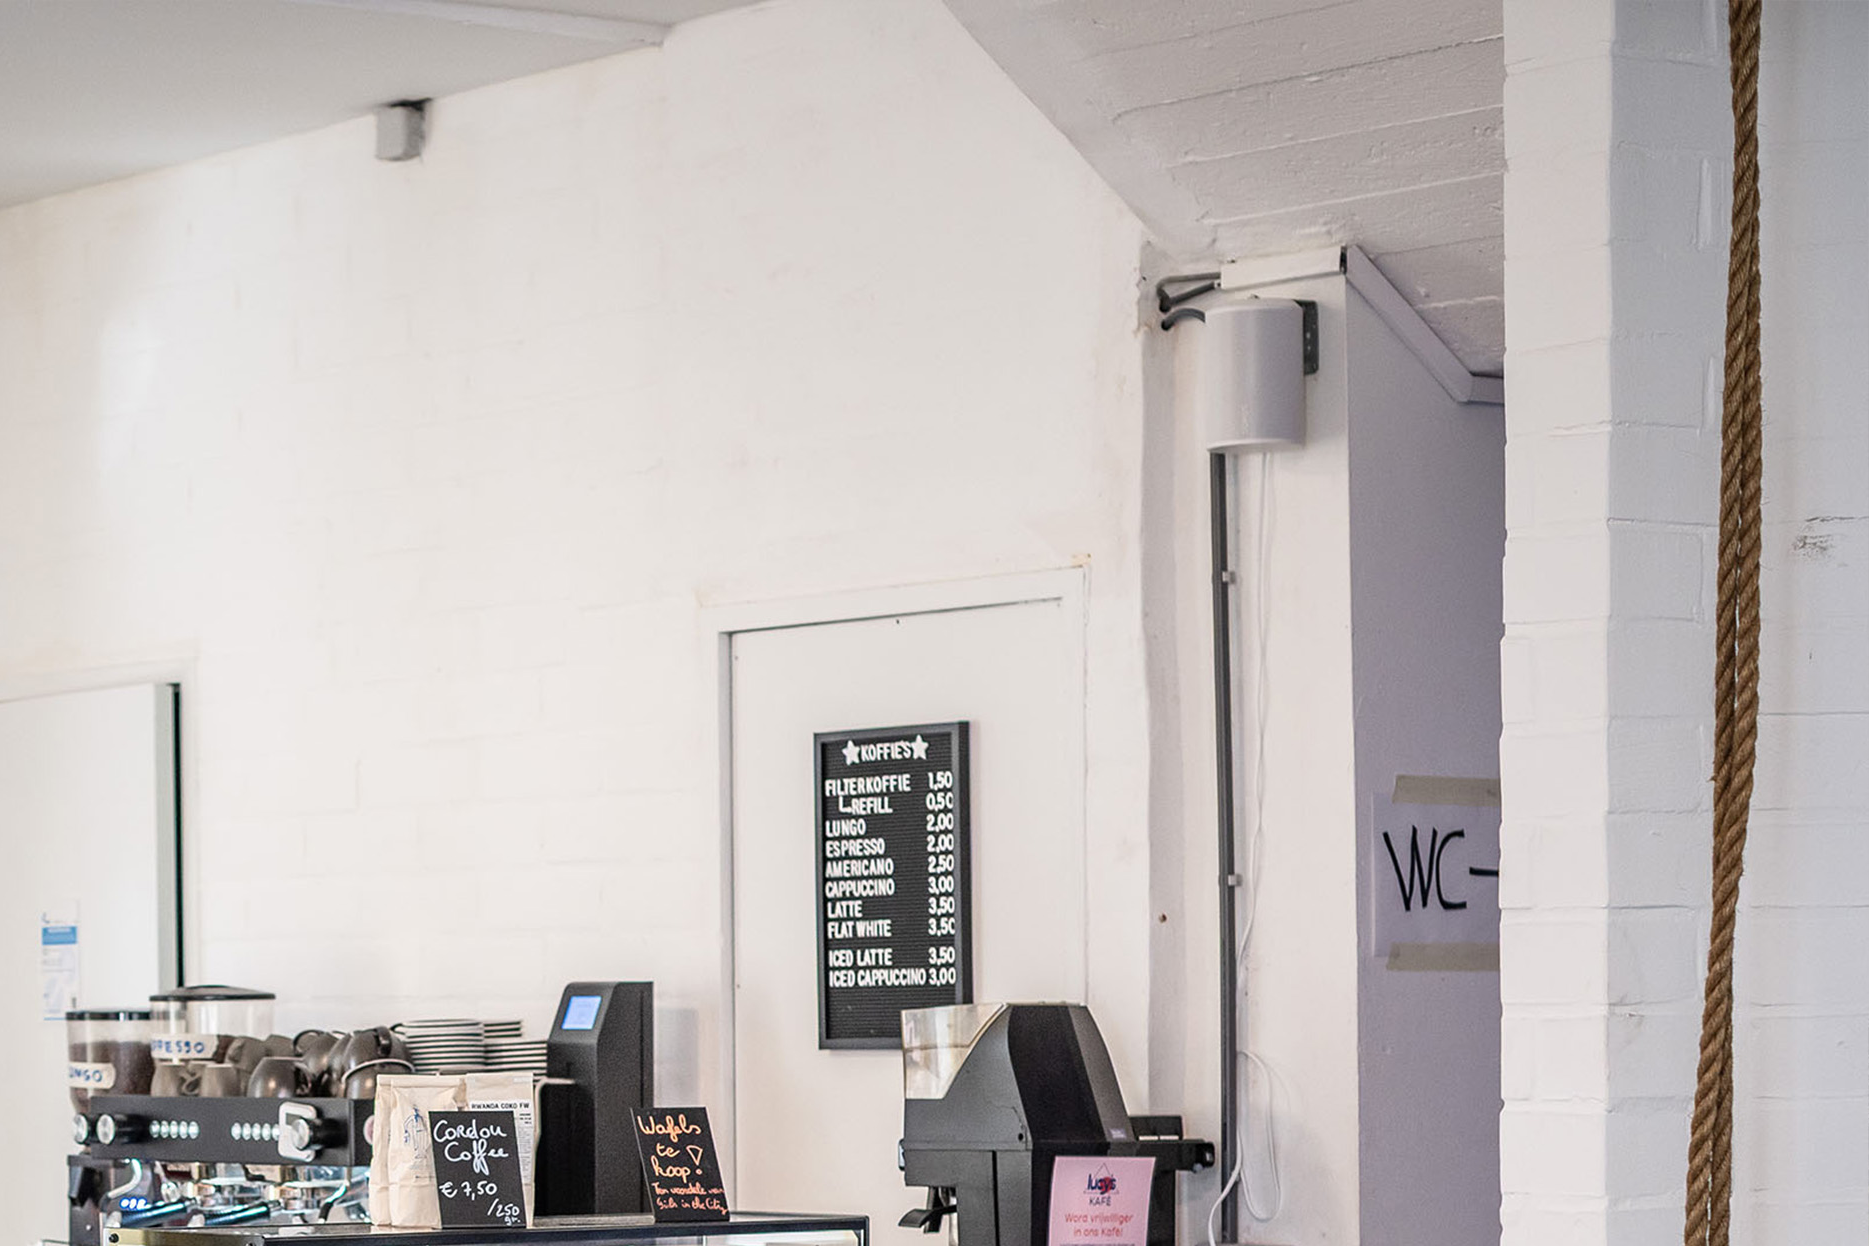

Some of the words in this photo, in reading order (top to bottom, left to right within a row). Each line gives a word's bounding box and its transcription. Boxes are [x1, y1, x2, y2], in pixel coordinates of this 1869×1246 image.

[824, 773, 911, 797] FILTERKOFFIE
[927, 770, 953, 791] 1,50
[925, 792, 953, 812] 0,50
[825, 818, 867, 838] LUNGO
[926, 812, 954, 832] 2,00
[825, 838, 885, 858] ESPRESSO
[926, 833, 954, 853] 2,00
[825, 858, 894, 878] AMERICANO
[927, 854, 955, 874] 2,50
[1382, 824, 1467, 912] WC
[825, 878, 895, 899] CAPPUCCINO
[928, 875, 955, 895] 3,00
[827, 900, 863, 918] LATTE
[928, 896, 955, 916] 3,50
[827, 921, 854, 939] FLAT
[856, 919, 892, 938] WHITE
[928, 917, 956, 937] 3,50
[829, 949, 854, 967] ICED
[856, 948, 893, 966] LATTE
[928, 946, 956, 966] 3,50
[829, 969, 855, 987] ICED
[857, 967, 926, 987] CAPPUCCINO
[928, 967, 956, 987] 3,00
[636, 1113, 702, 1143] Wafels
[444, 1138, 509, 1176] Coffee
[656, 1142, 680, 1157] te
[1065, 1212, 1088, 1224] Word
